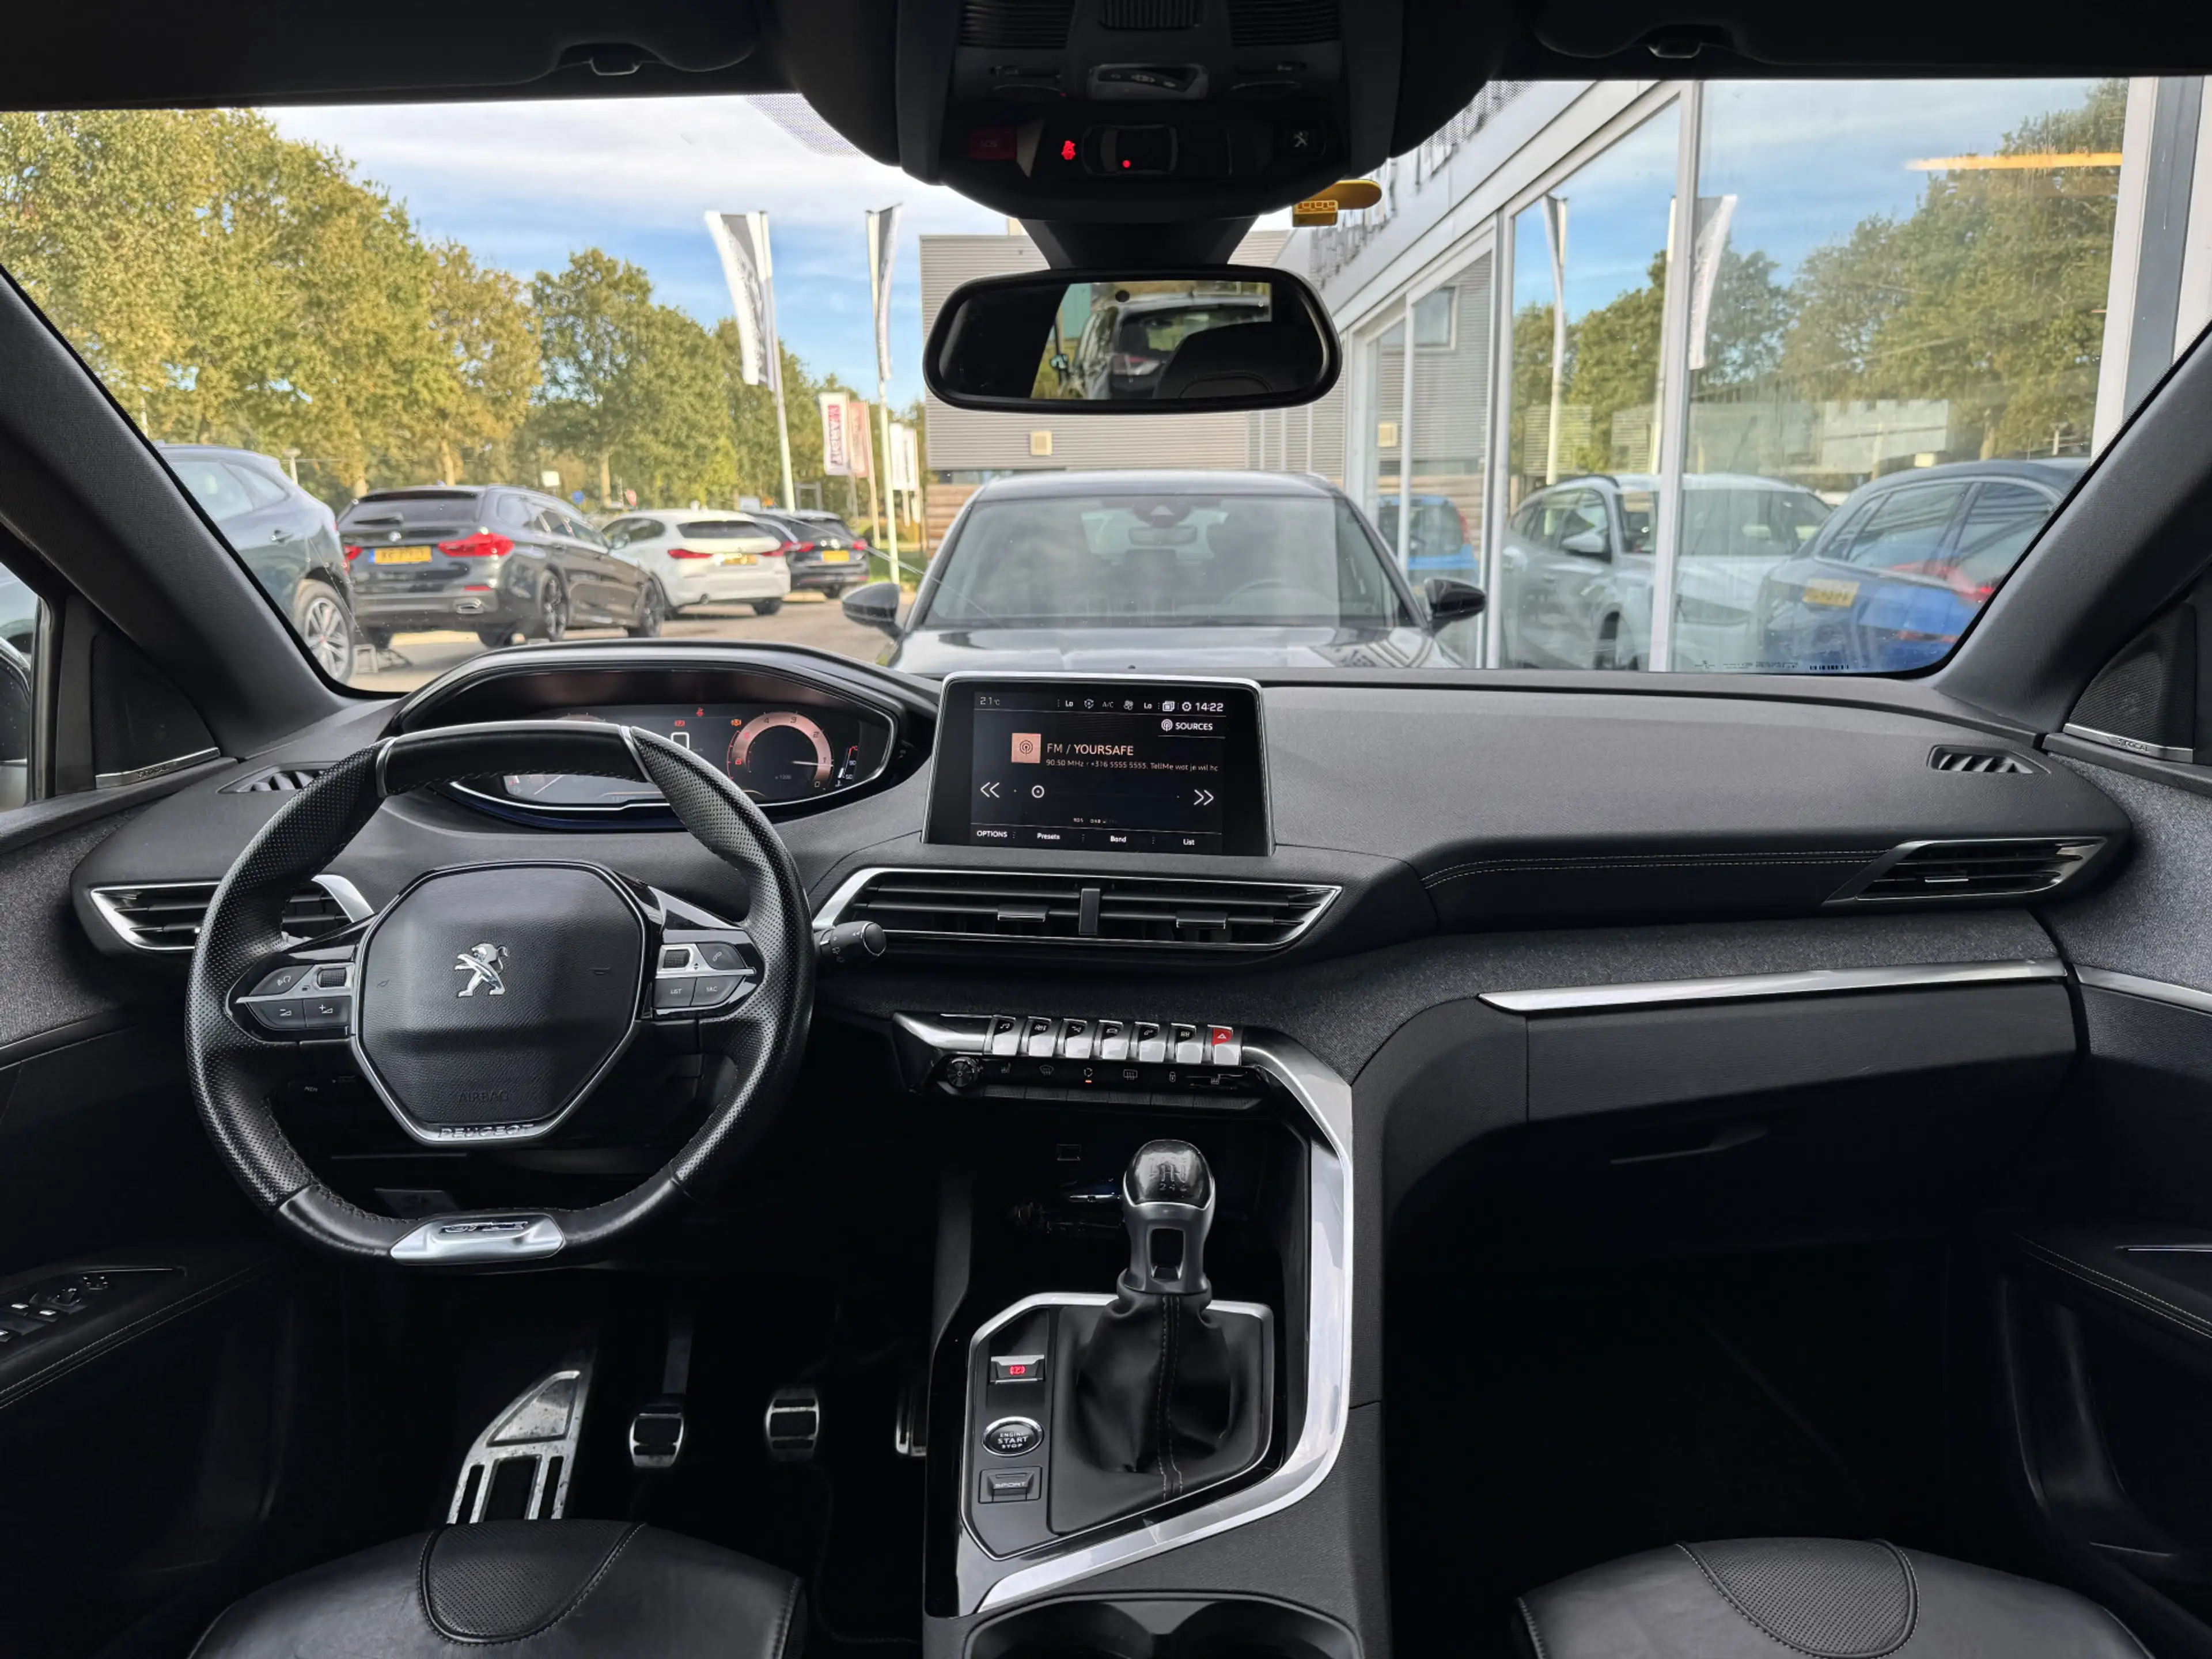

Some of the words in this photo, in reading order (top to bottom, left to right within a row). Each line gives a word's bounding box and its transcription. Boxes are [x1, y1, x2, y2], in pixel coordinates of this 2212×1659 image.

[1195, 702, 1224, 712] 14:22
[1175, 722, 1213, 730] SOURCES
[1047, 743, 1063, 753] FM
[1074, 744, 1134, 756] YOURSAFE
[1150, 762, 1174, 770] TellMe
[1190, 763, 1197, 772] je
[438, 1124, 534, 1138] PEUGEOT
[997, 1436, 1029, 1445] START
